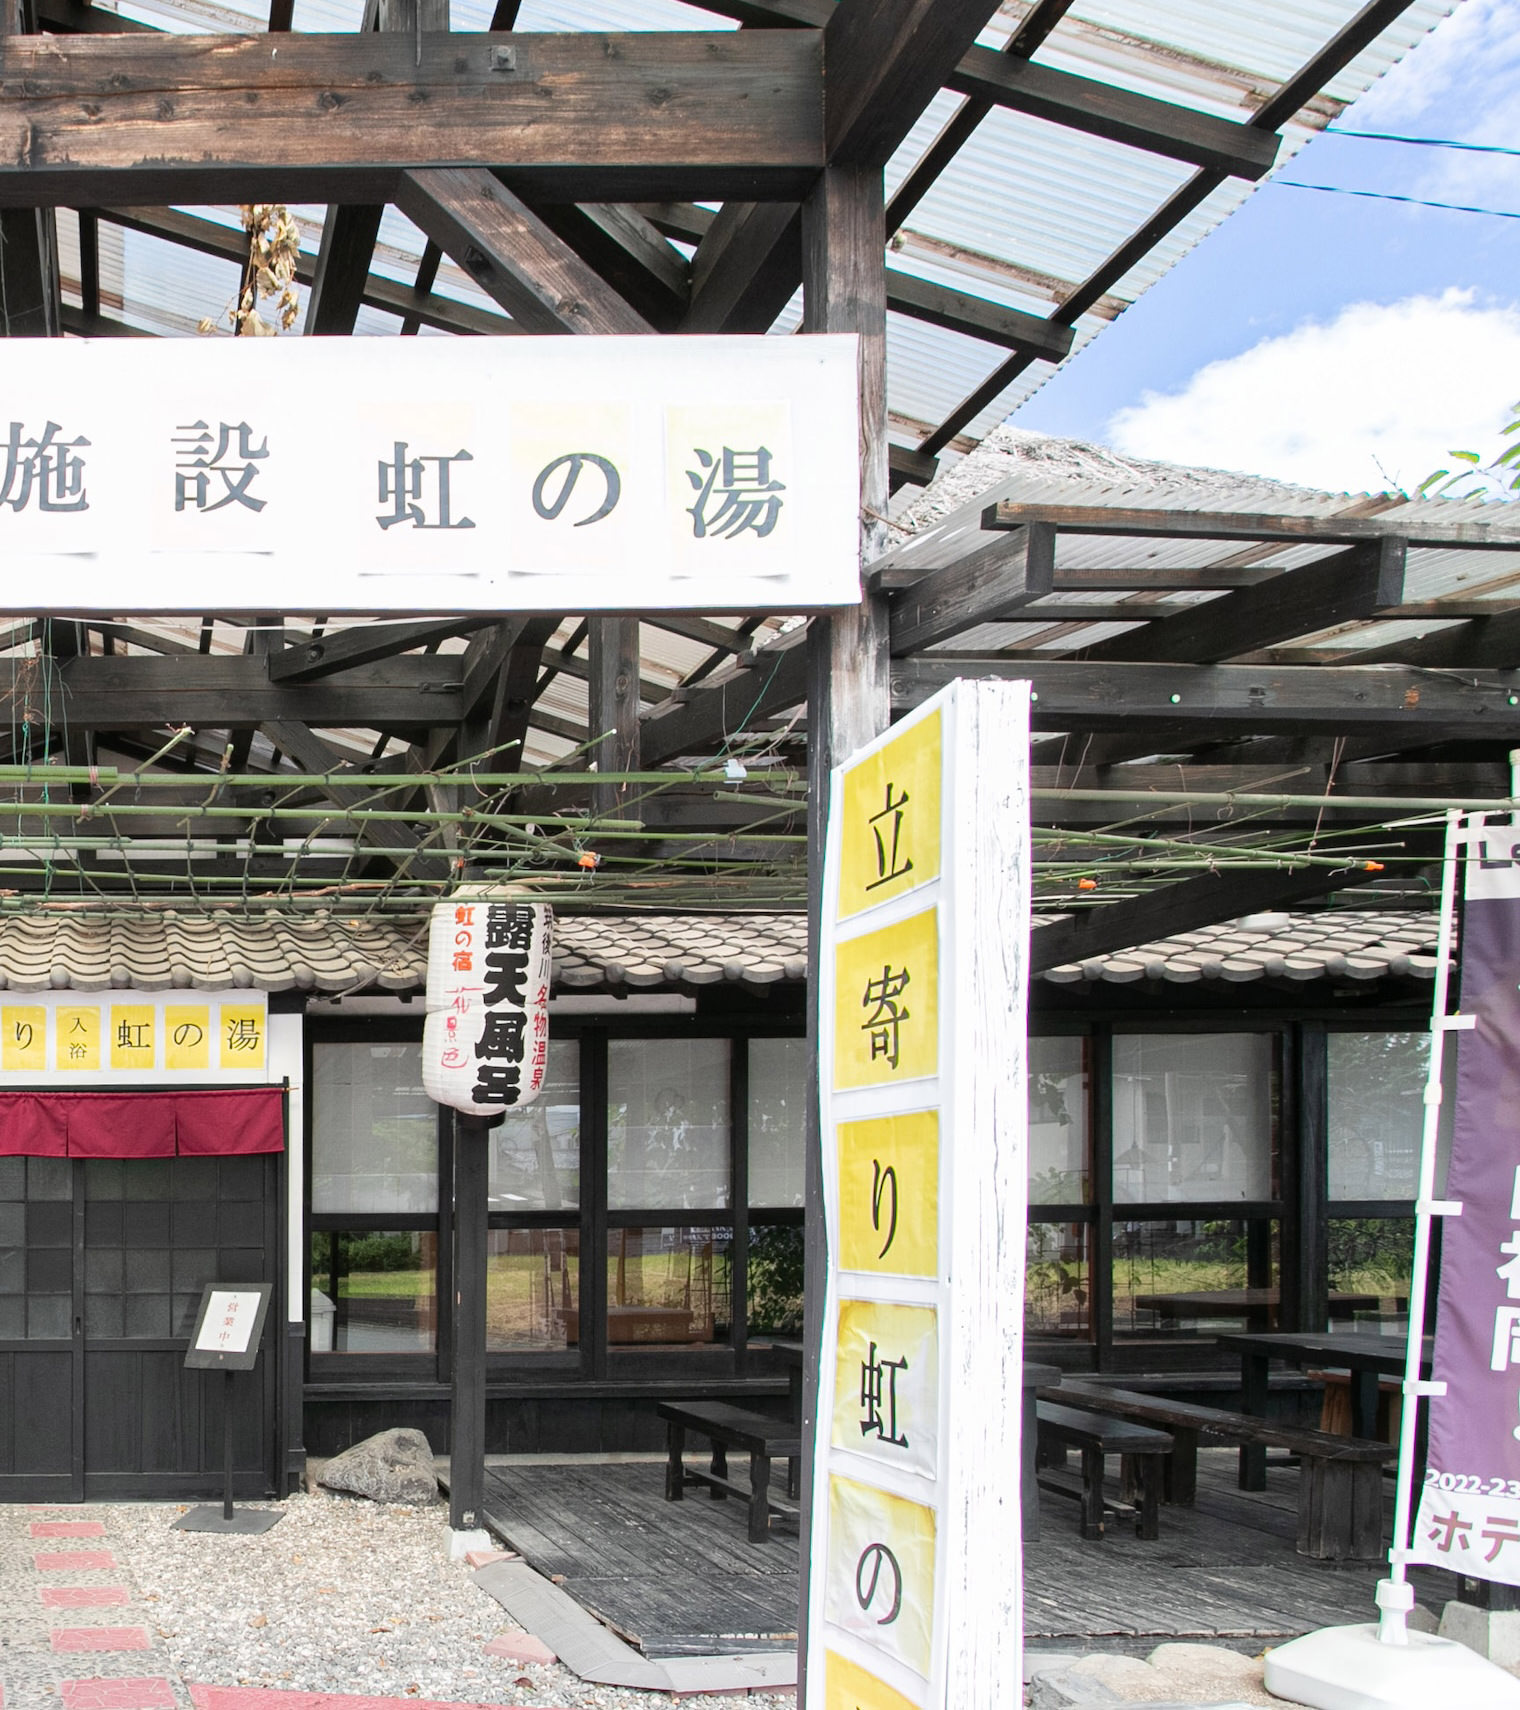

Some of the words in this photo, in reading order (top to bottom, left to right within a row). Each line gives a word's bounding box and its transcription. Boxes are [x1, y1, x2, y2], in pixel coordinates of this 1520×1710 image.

[452, 905, 475, 972] 虹の宿
[471, 903, 537, 1106] 露天風呂
[529, 983, 548, 1091] 名物温泉
[855, 782, 914, 1710] 立寄り虹の
